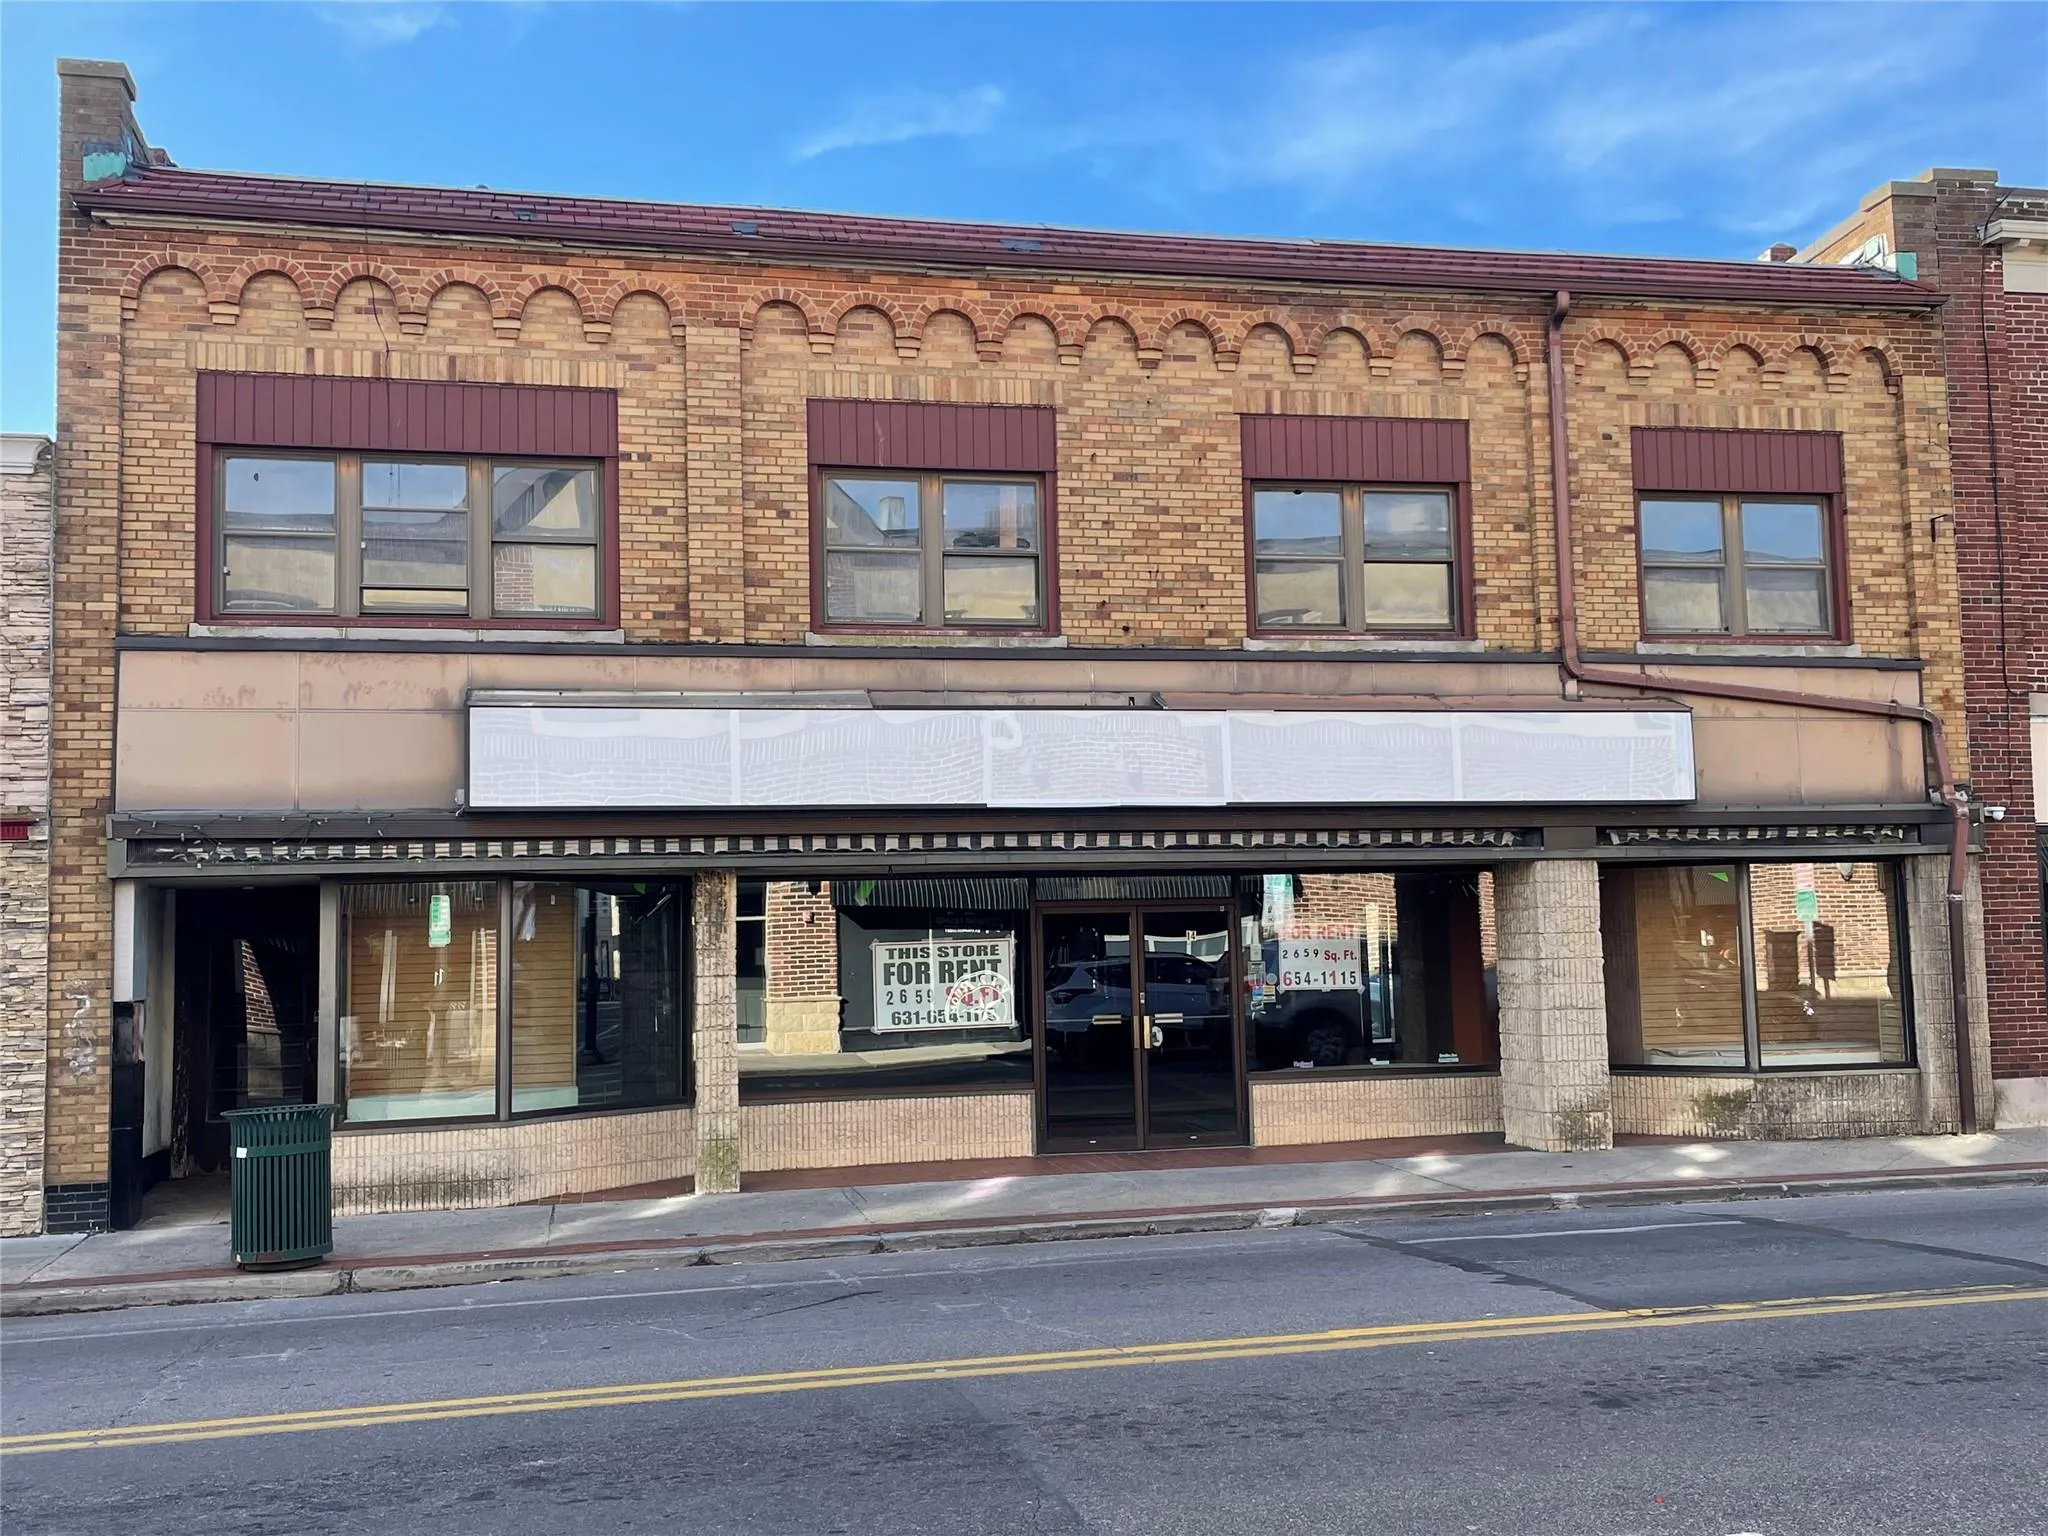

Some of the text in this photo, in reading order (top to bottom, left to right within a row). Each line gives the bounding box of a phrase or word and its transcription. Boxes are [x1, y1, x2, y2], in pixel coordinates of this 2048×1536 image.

[1187, 931, 1196, 941] 14
[885, 944, 1000, 960] THIS STORE
[1282, 948, 1357, 963] 2659 Sq. Ft.
[883, 961, 931, 986] FOR
[938, 959, 1002, 984] RENT
[1283, 970, 1357, 987] 654-1115
